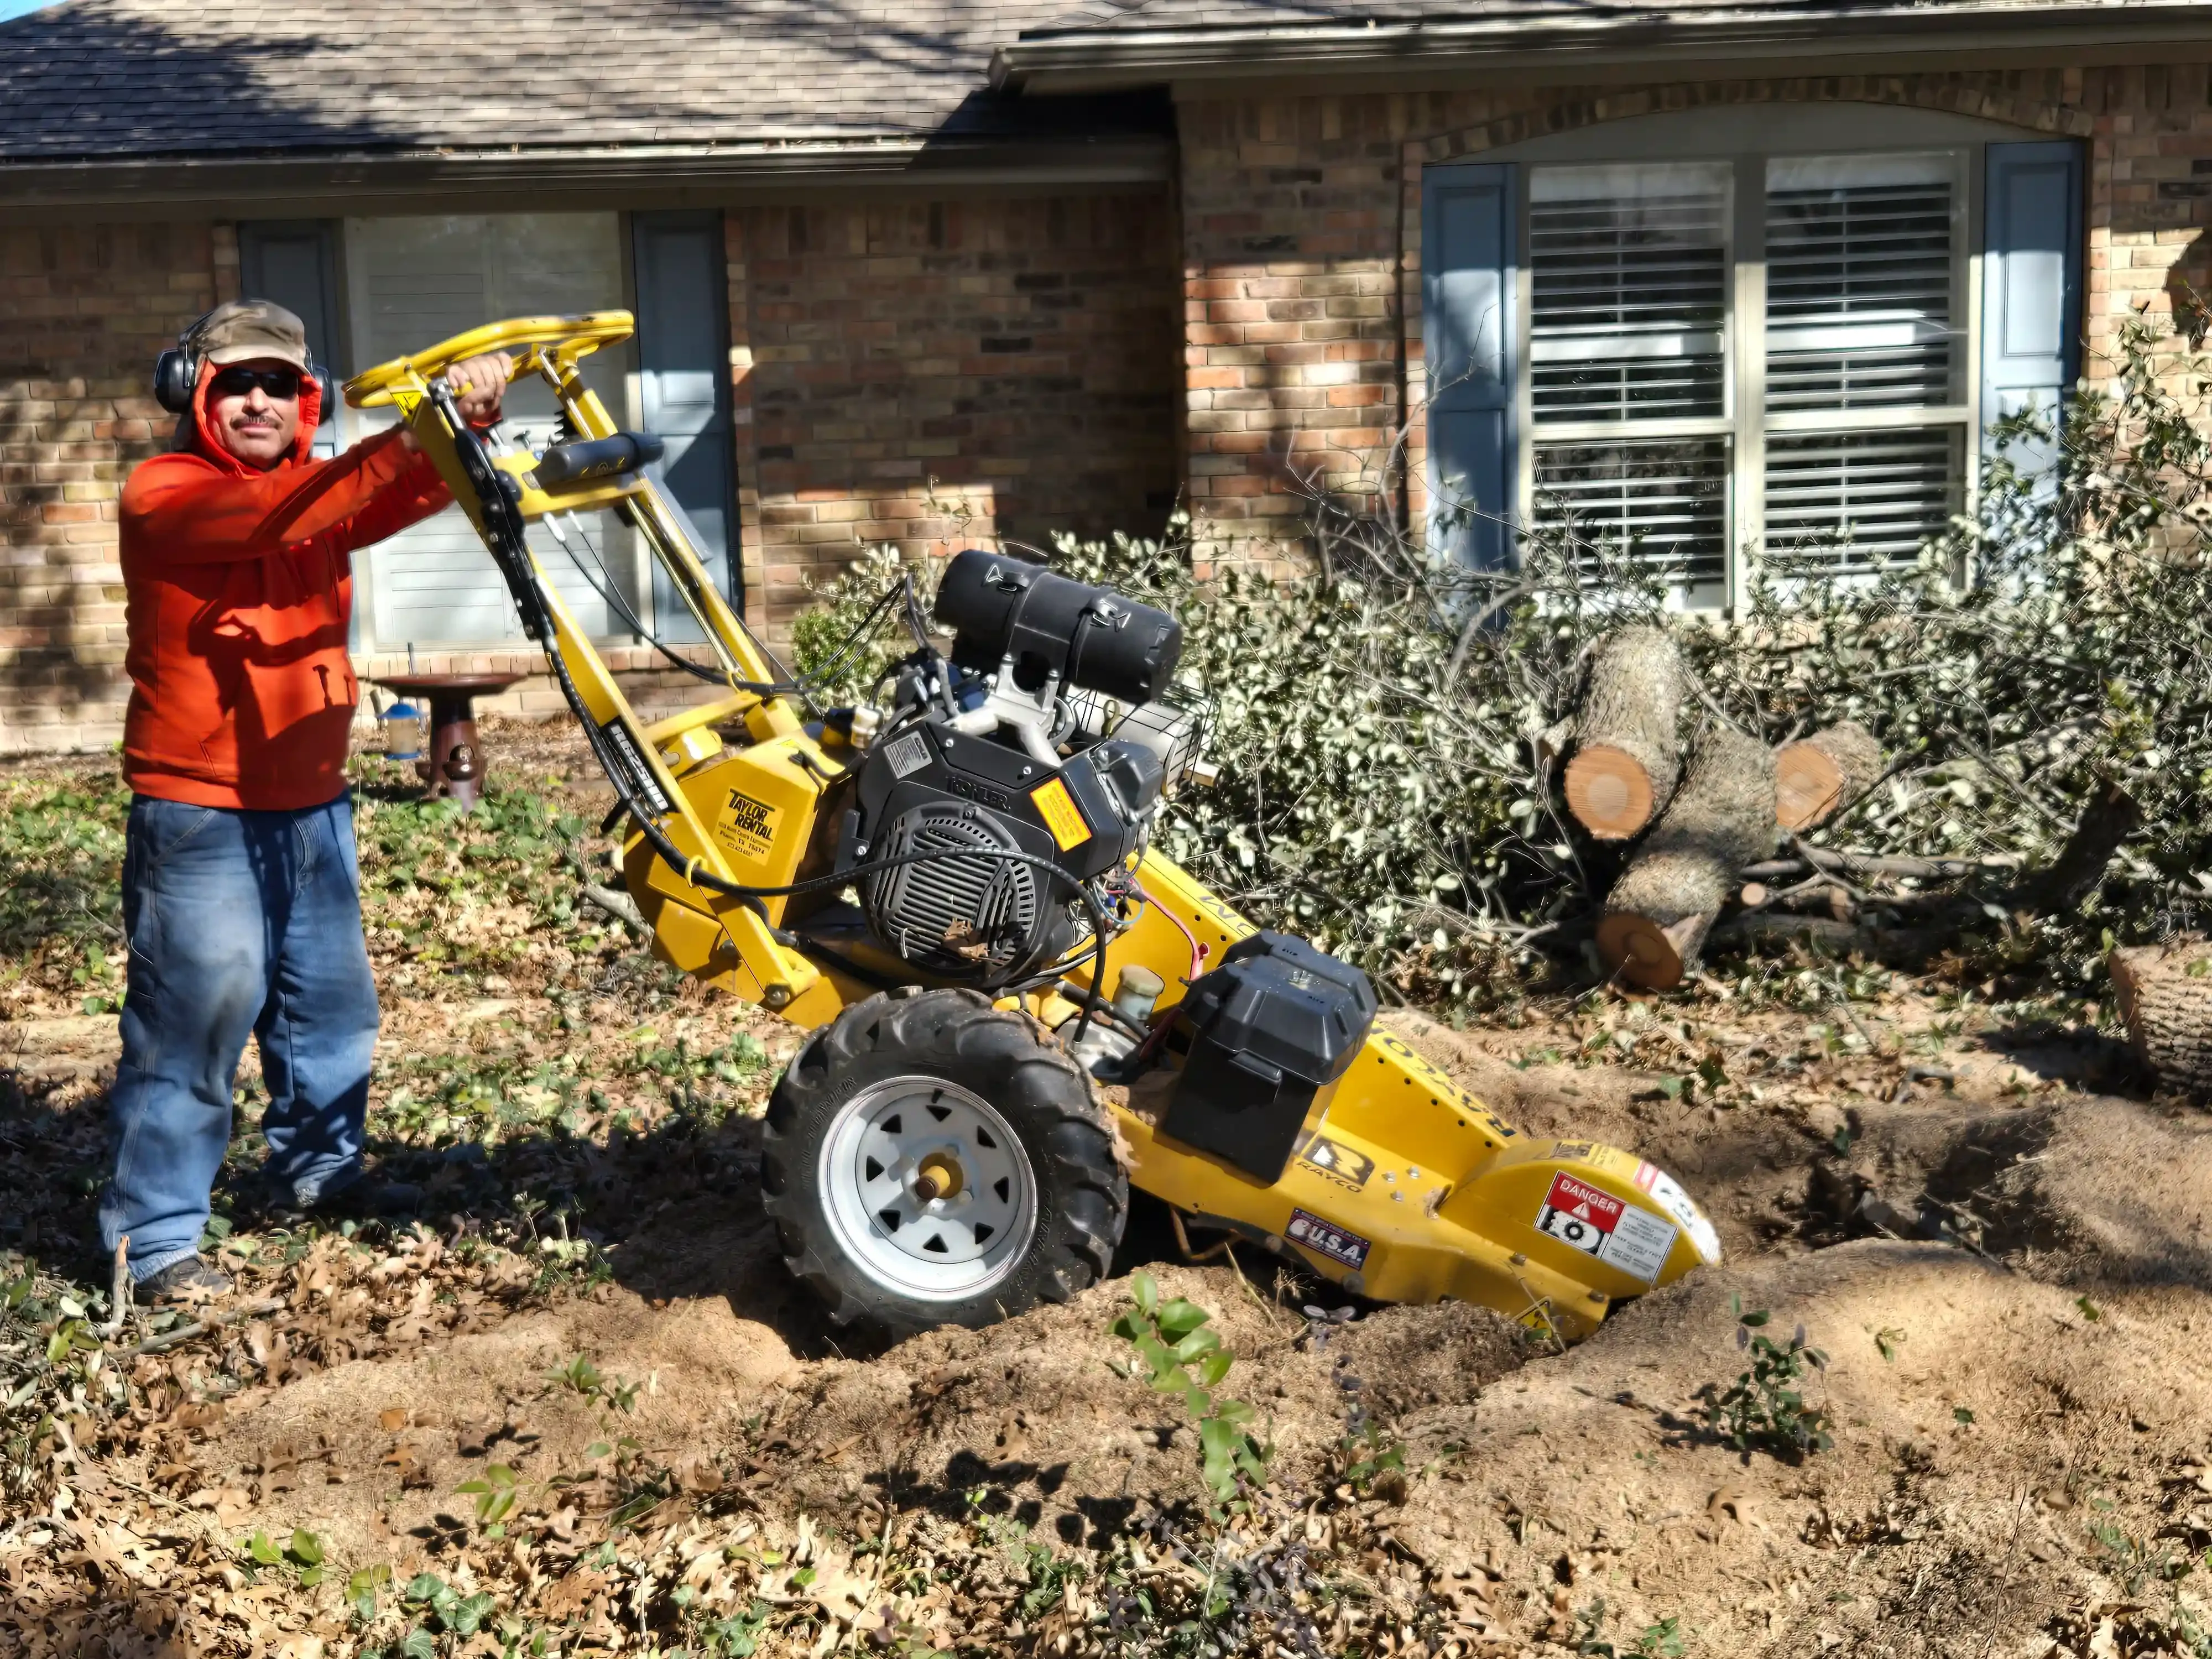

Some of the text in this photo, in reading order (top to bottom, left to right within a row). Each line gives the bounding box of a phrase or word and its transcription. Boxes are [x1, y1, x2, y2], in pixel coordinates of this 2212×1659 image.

[729, 788, 775, 822] TAYLOR
[734, 813, 774, 842] RENTAL
[1296, 1161, 1362, 1193] RAYCO
[1559, 1178, 1619, 1215] DANGER
[1308, 1225, 1362, 1262] U.S.A.
